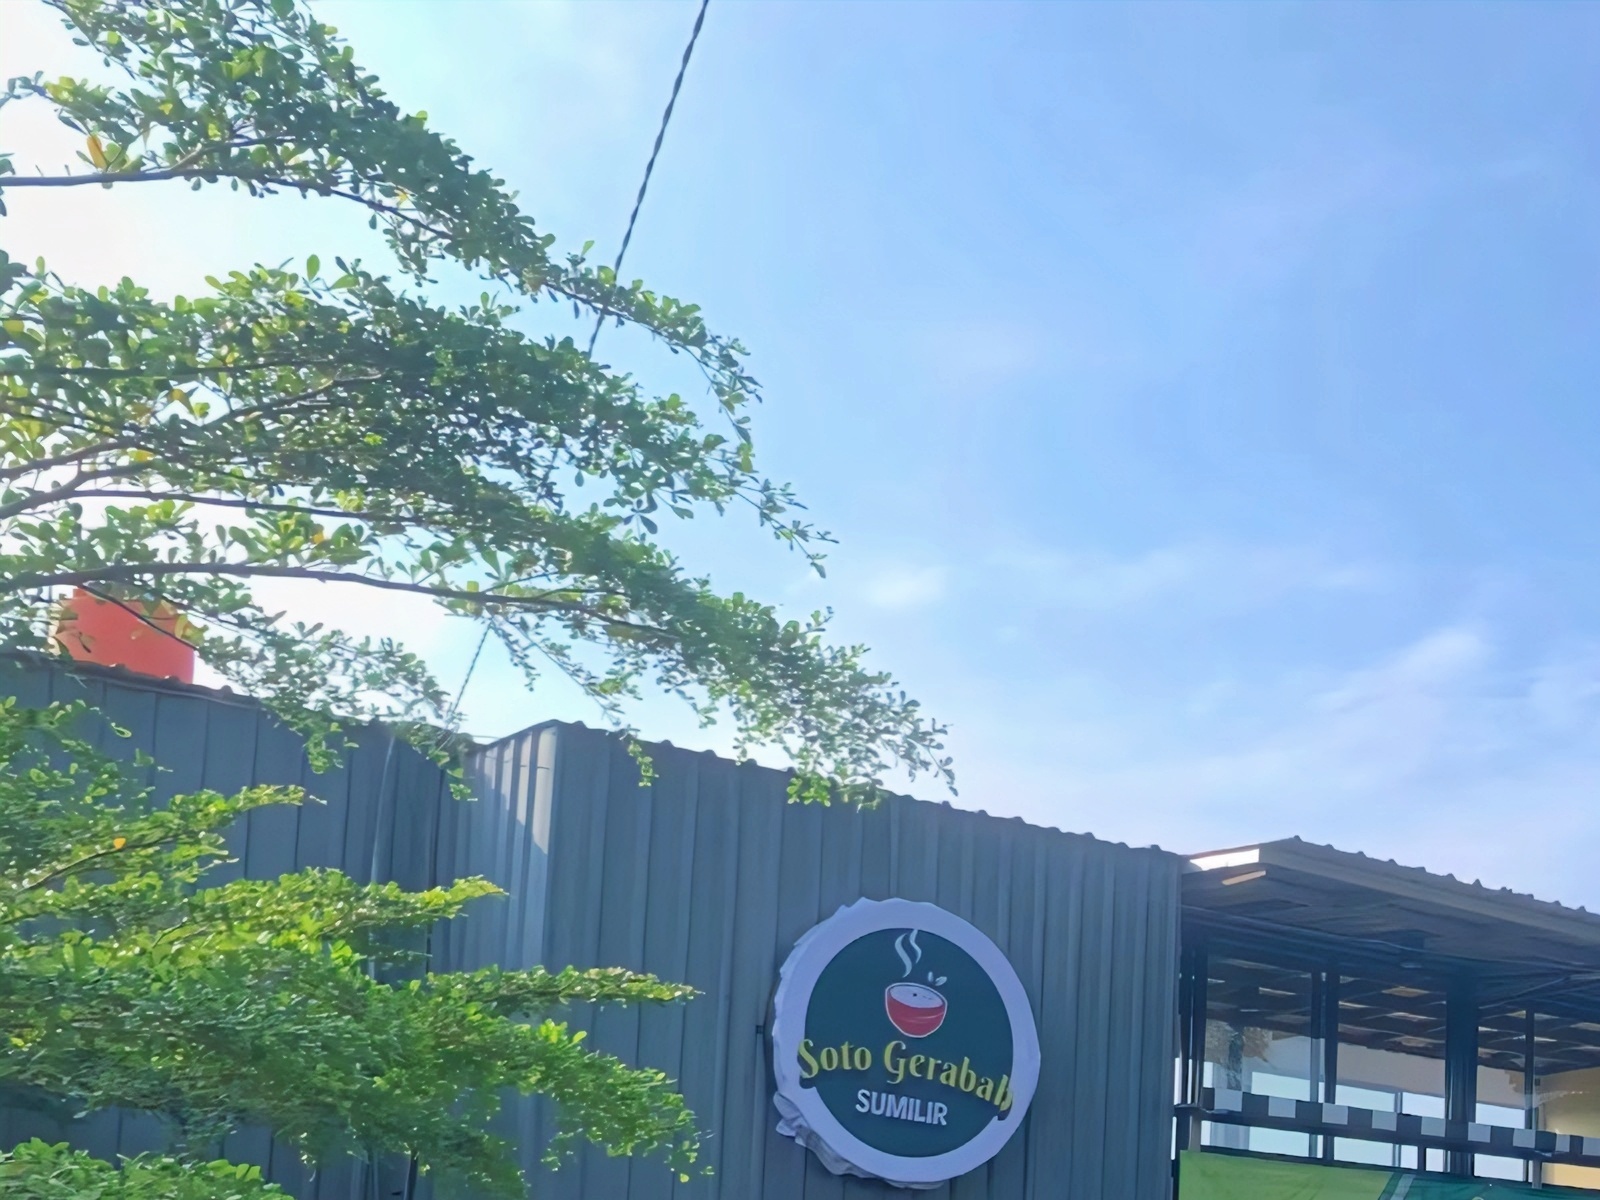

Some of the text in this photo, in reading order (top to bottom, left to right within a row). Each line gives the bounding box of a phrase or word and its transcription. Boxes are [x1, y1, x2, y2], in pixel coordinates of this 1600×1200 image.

[797, 1039, 1014, 1111] Soto Gerabah
[856, 1089, 948, 1125] SUMILIR
